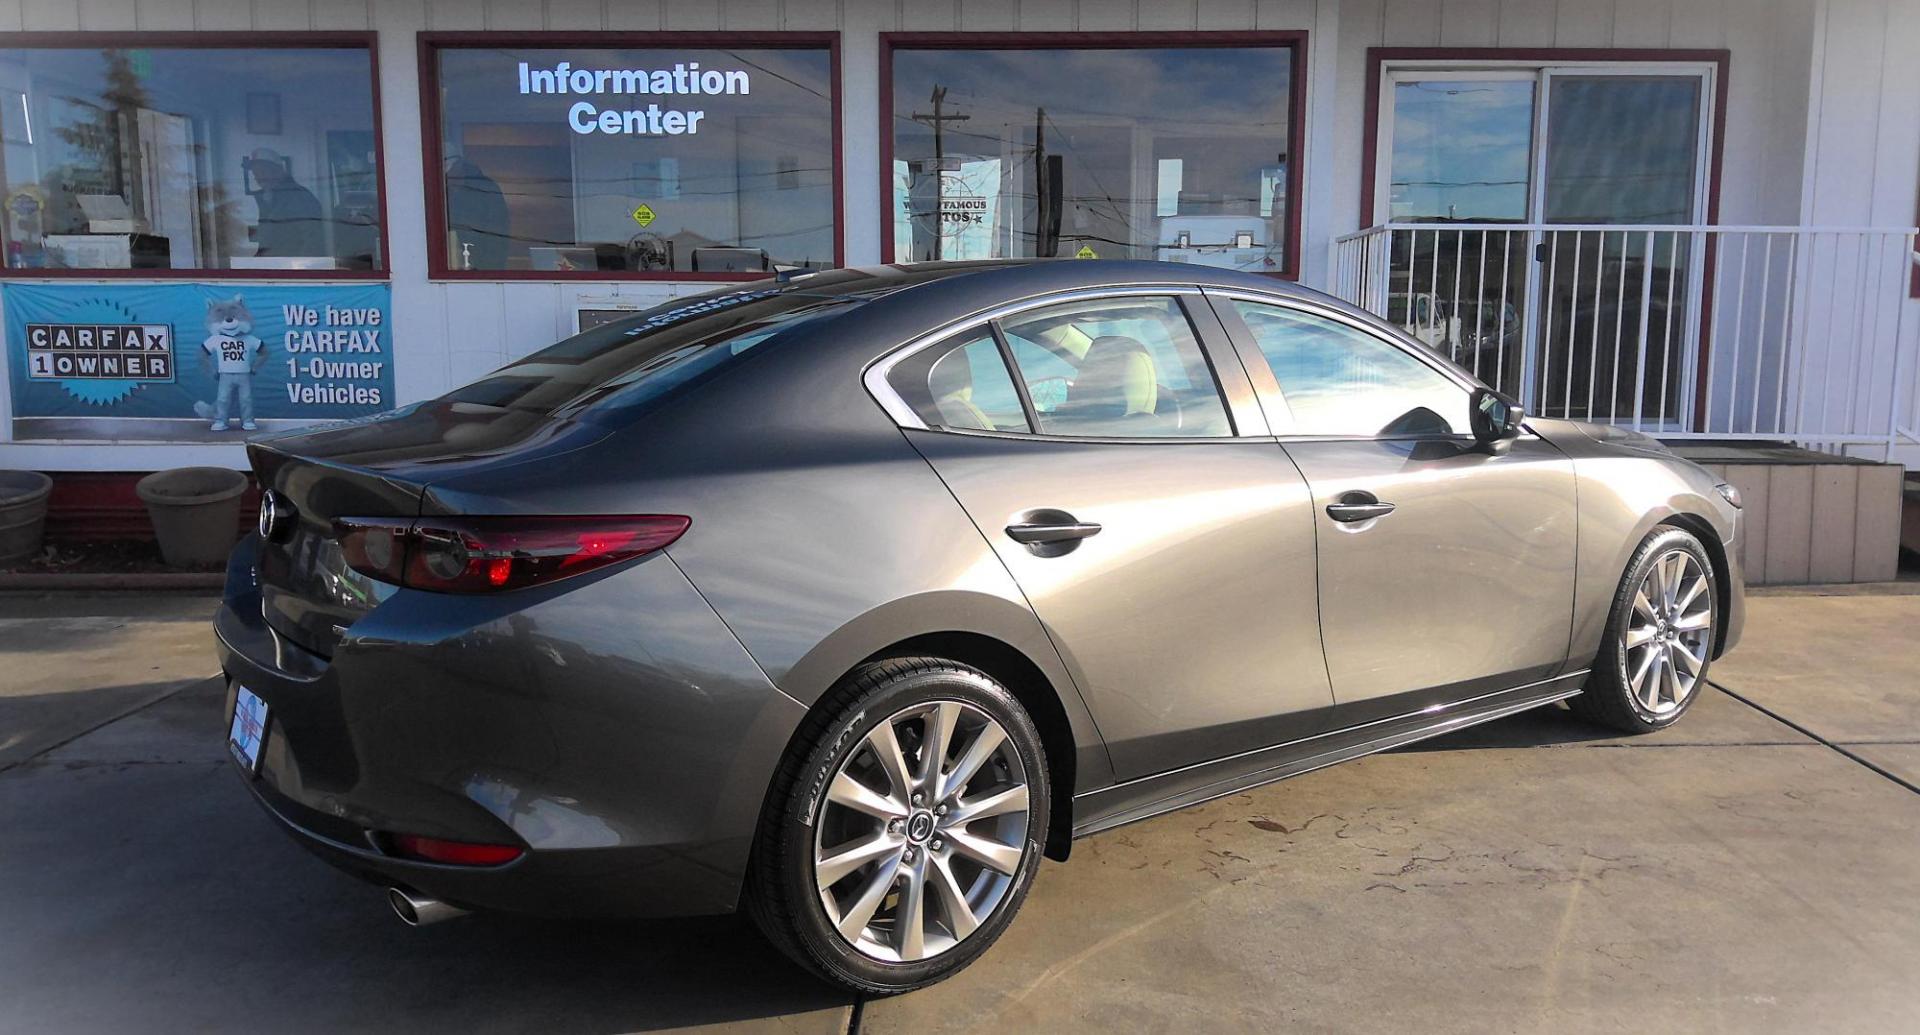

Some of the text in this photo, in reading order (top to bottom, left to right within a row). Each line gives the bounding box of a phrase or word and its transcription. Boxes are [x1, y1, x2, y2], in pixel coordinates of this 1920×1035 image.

[519, 62, 750, 95] Information
[568, 102, 704, 135] Center
[943, 201, 987, 210] FAMOUS
[283, 304, 381, 326] We have
[31, 328, 165, 350] CARFAX
[220, 341, 245, 350] CAR
[284, 330, 381, 353] CARFAX
[223, 351, 245, 361] FOX
[286, 357, 382, 378] 1-Owner
[286, 383, 381, 404] Vehicles
